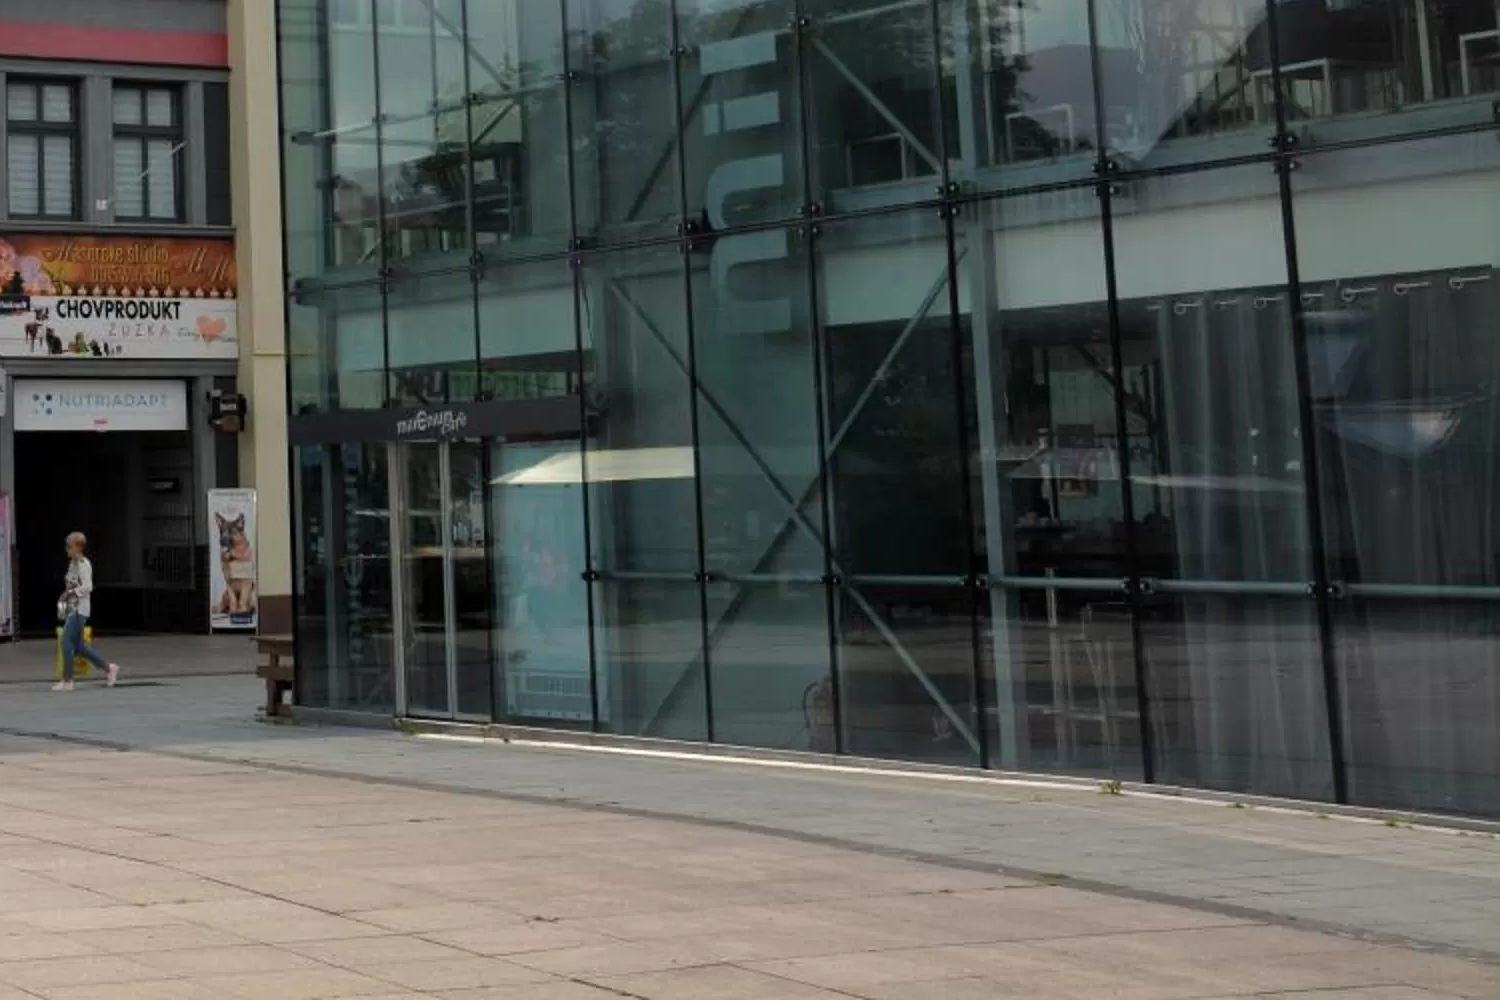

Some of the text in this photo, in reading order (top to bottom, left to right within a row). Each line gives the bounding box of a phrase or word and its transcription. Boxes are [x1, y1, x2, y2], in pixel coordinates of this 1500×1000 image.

[56, 299, 182, 320] CHOVPRODUKT
[108, 323, 171, 338] ZUZKA
[58, 391, 169, 409] NUTRIADAPT
